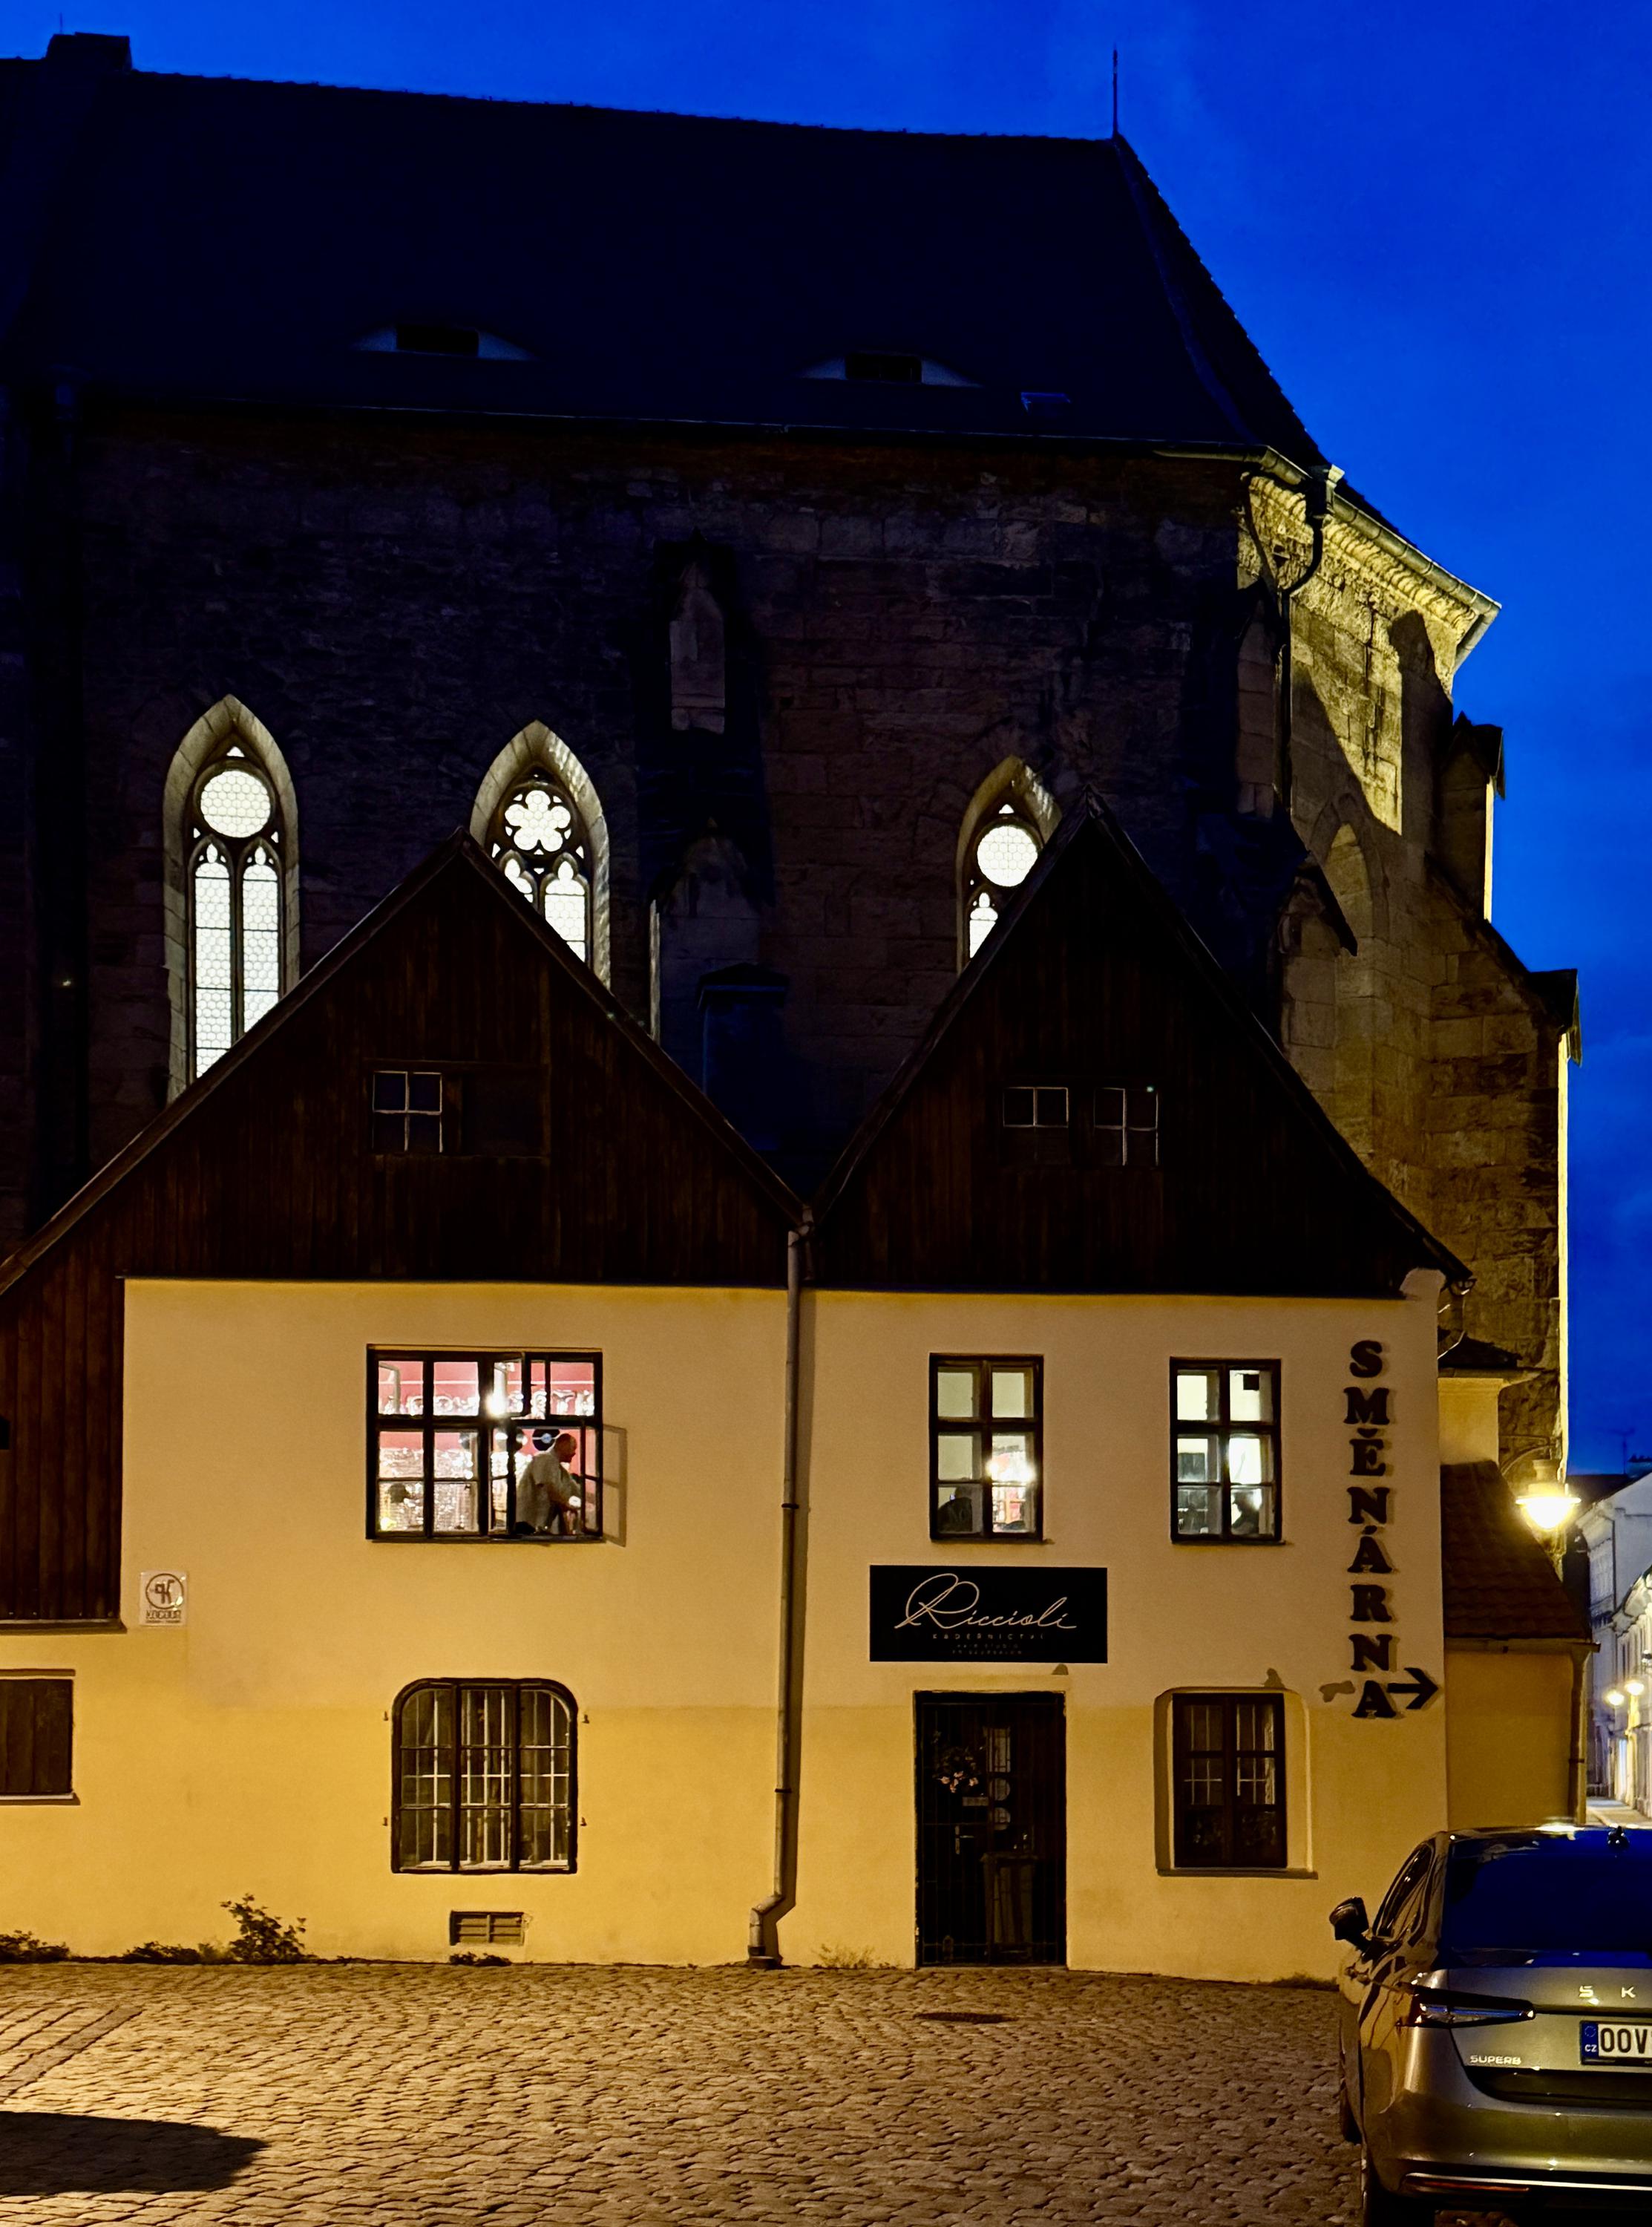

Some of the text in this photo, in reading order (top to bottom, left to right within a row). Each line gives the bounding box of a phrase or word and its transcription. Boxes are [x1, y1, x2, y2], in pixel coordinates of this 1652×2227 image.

[1343, 1339, 1397, 1719] SMĚNÁRNA
[894, 1572, 1077, 1629] Riccioli
[1469, 2054, 1522, 2066] SUPERB
[1584, 2044, 1598, 2053] CZ
